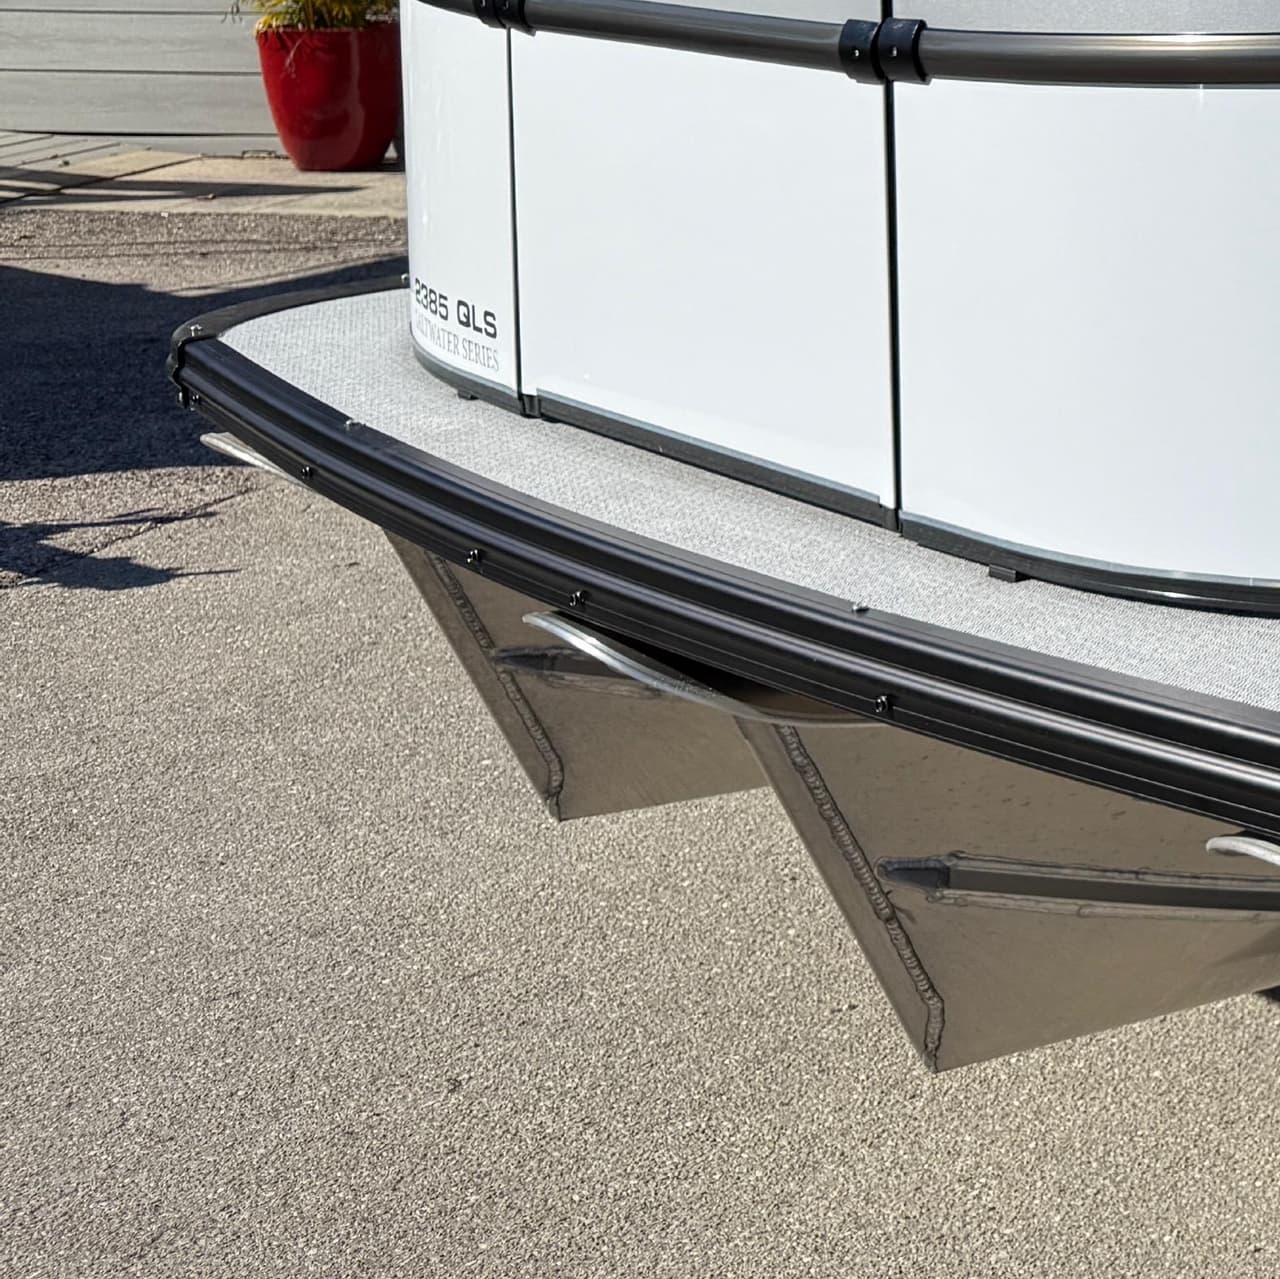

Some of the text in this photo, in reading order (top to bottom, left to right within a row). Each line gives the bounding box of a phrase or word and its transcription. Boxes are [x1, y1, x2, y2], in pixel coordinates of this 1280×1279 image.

[415, 277, 497, 339] 2385 QLS
[416, 309, 499, 372] ALTWATER SERIES
